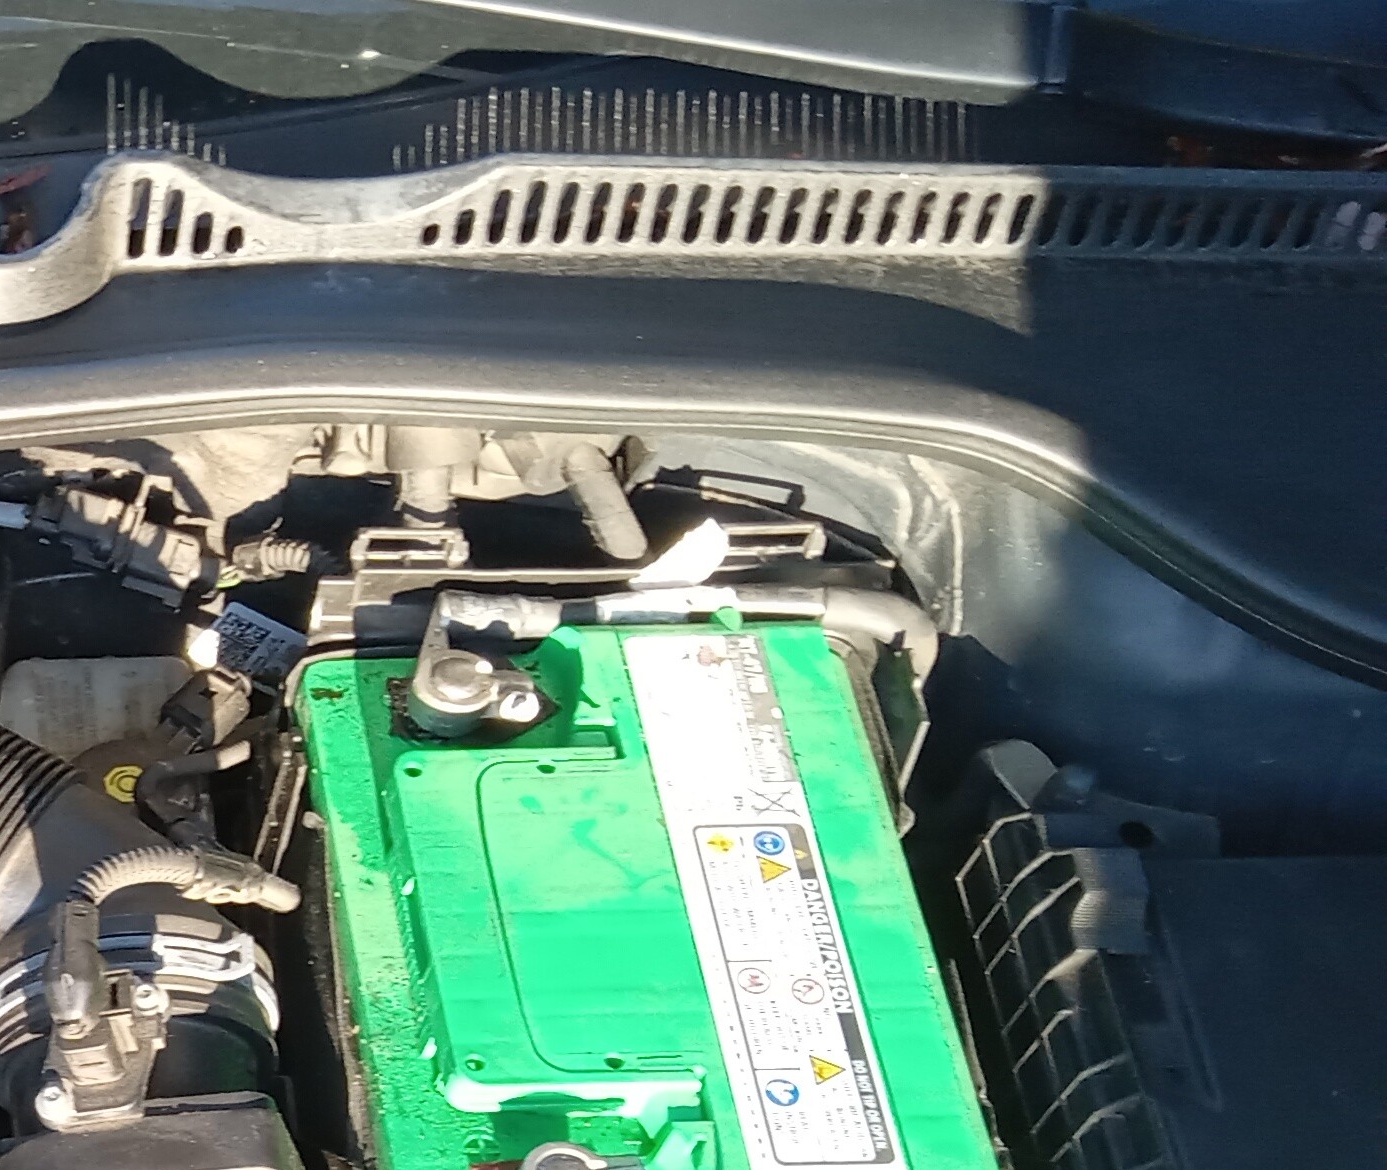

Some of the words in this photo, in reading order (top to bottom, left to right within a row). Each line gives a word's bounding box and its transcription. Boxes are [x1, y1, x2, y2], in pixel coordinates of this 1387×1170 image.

[801, 878, 855, 1014] DANGER/POISON
[851, 1059, 869, 1074] DO
[855, 1074, 874, 1093] NOT
[860, 1093, 878, 1109] TIP
[865, 1109, 883, 1123] OR
